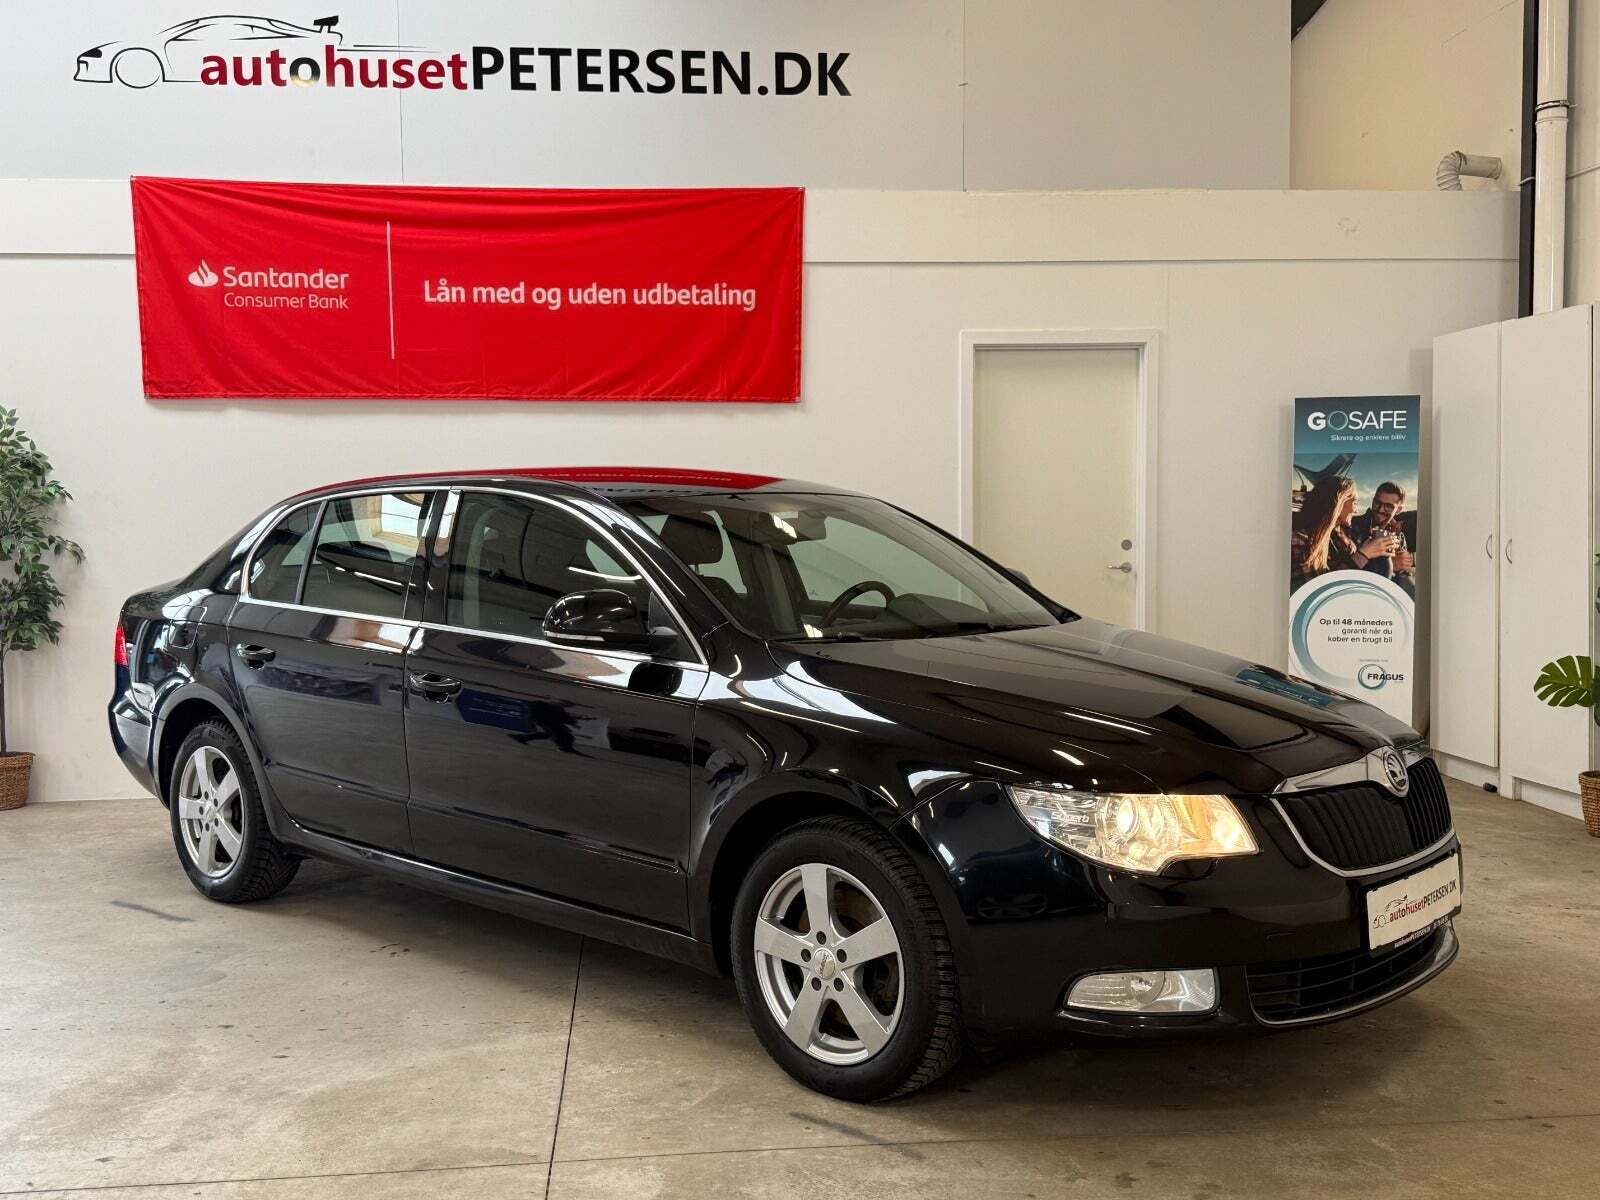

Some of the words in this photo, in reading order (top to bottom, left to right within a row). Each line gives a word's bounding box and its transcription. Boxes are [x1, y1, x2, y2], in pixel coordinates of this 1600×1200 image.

[201, 45, 852, 97] autohusetPETERSEN.DK
[223, 266, 349, 289] Santander
[224, 292, 306, 309] Consumer
[309, 294, 349, 309] Bank
[424, 278, 465, 304] Lån
[473, 281, 525, 305] med
[532, 287, 561, 310] og
[569, 282, 626, 306] uden
[633, 283, 757, 311] udbetaling
[1307, 410, 1407, 431] GOSAFE
[1320, 618, 1332, 626] Op
[1341, 618, 1353, 626] 48
[1354, 618, 1393, 627] måneders
[1341, 628, 1367, 636] garanti
[1369, 627, 1381, 635] når
[1362, 636, 1381, 644] brugt
[1367, 673, 1404, 681] FRAGUS
[1389, 879, 1458, 922] autohusetPETERSEN.DK
